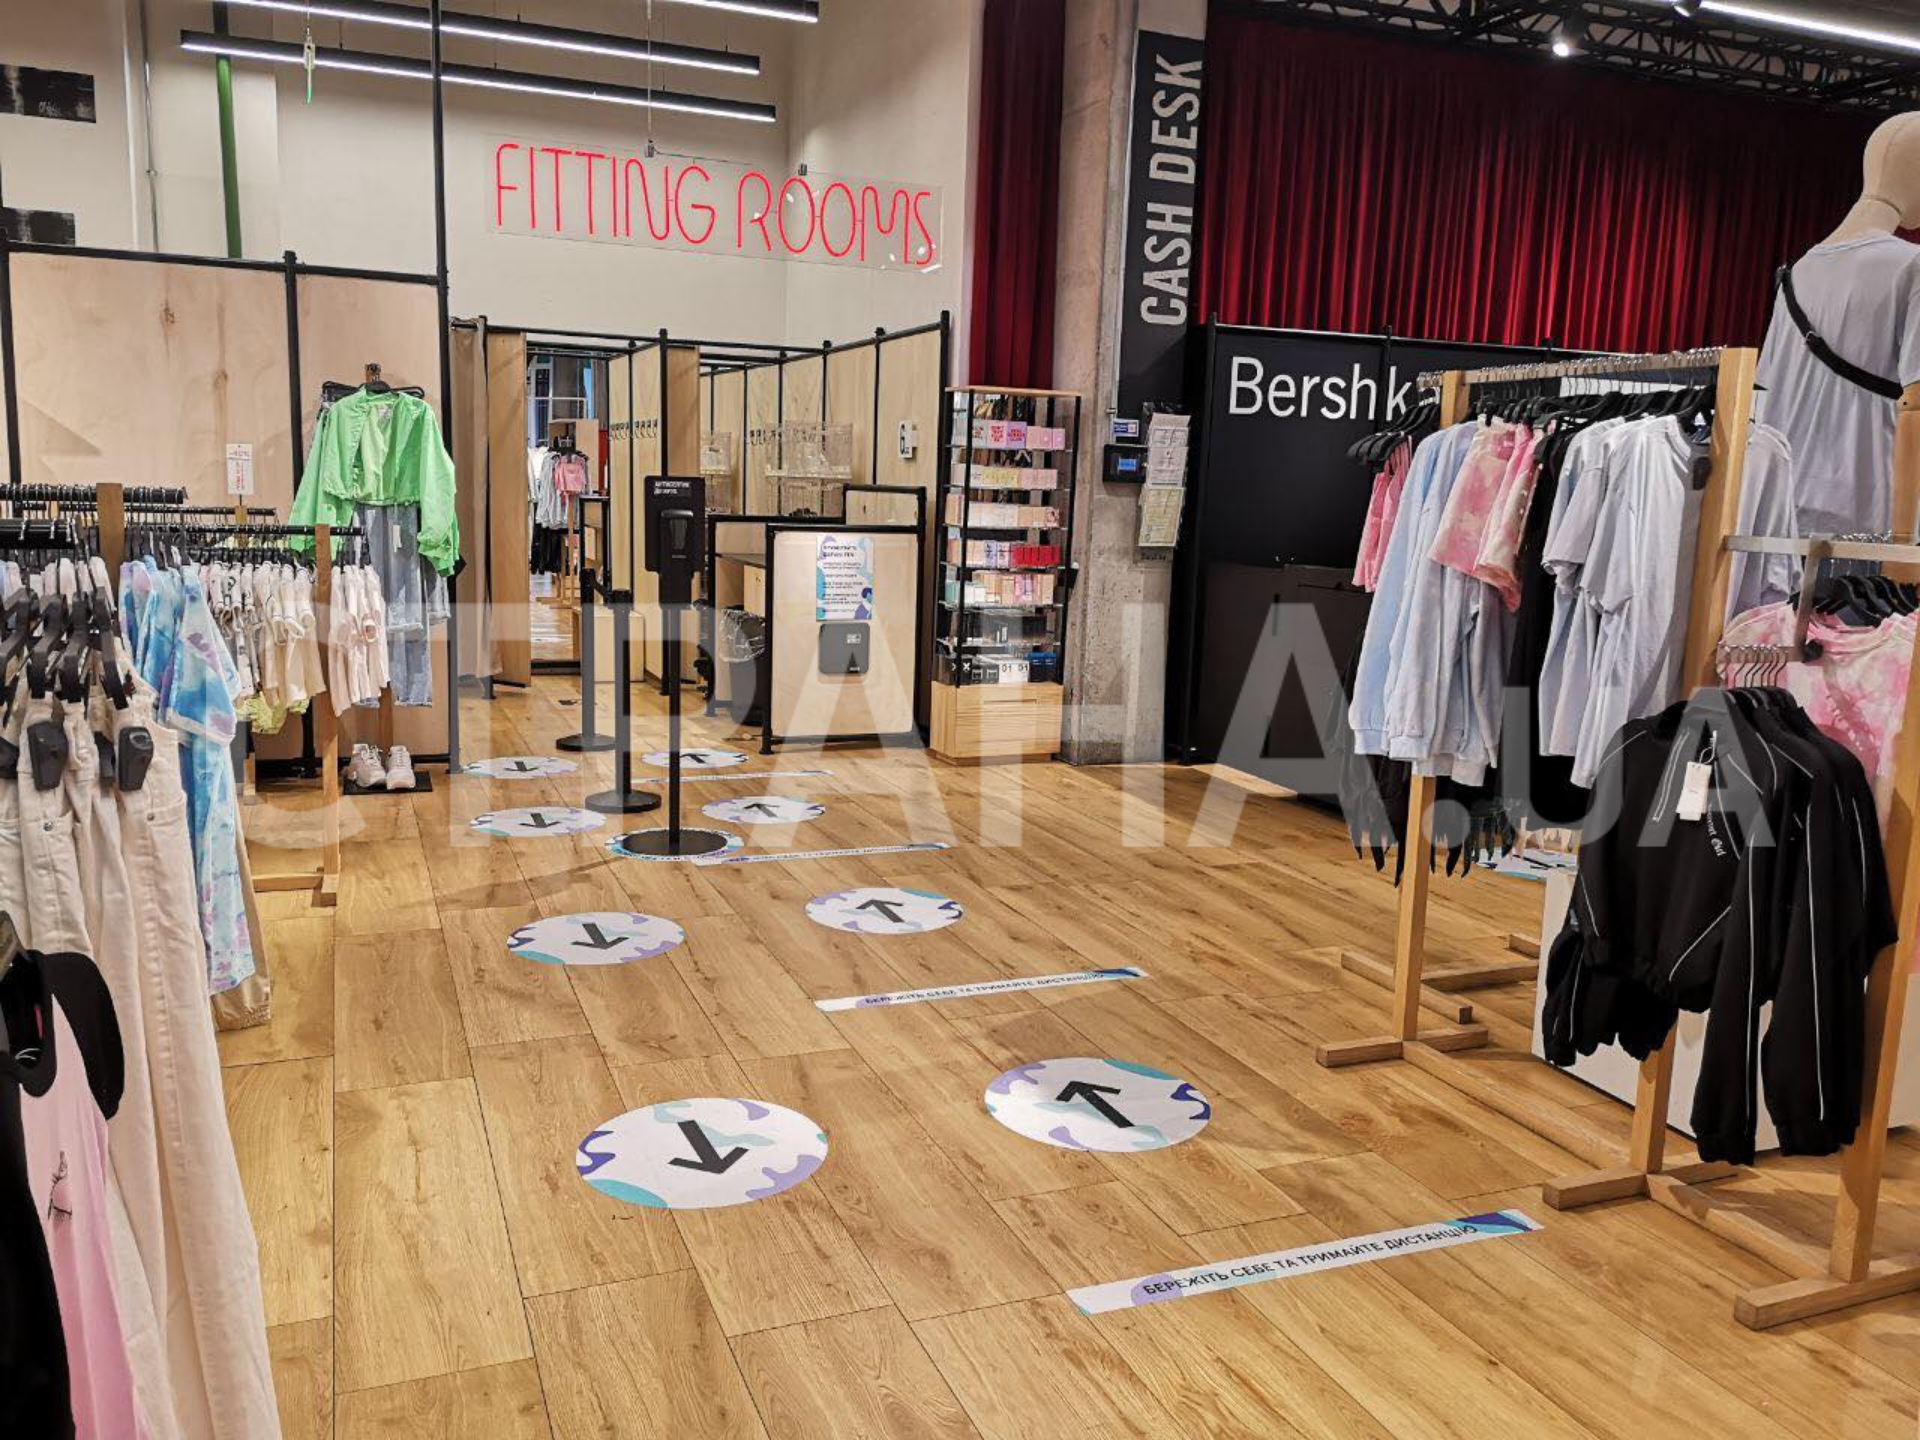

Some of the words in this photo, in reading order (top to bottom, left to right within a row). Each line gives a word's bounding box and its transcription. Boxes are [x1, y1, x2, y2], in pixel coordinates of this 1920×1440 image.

[1148, 53, 1204, 185] DESK
[496, 142, 716, 244] FITTING
[737, 171, 935, 265] ROOMS
[1140, 202, 1194, 326] CASH
[1143, 1272, 1229, 1295] БЕРЕЖІТЬ
[1230, 1262, 1275, 1278] СЕБЕ
[1273, 1256, 1297, 1271] ТА
[1298, 1243, 1384, 1265] ТРИМАЙТЕ
[1384, 1225, 1478, 1250] ДИСТАНЦІЮ
